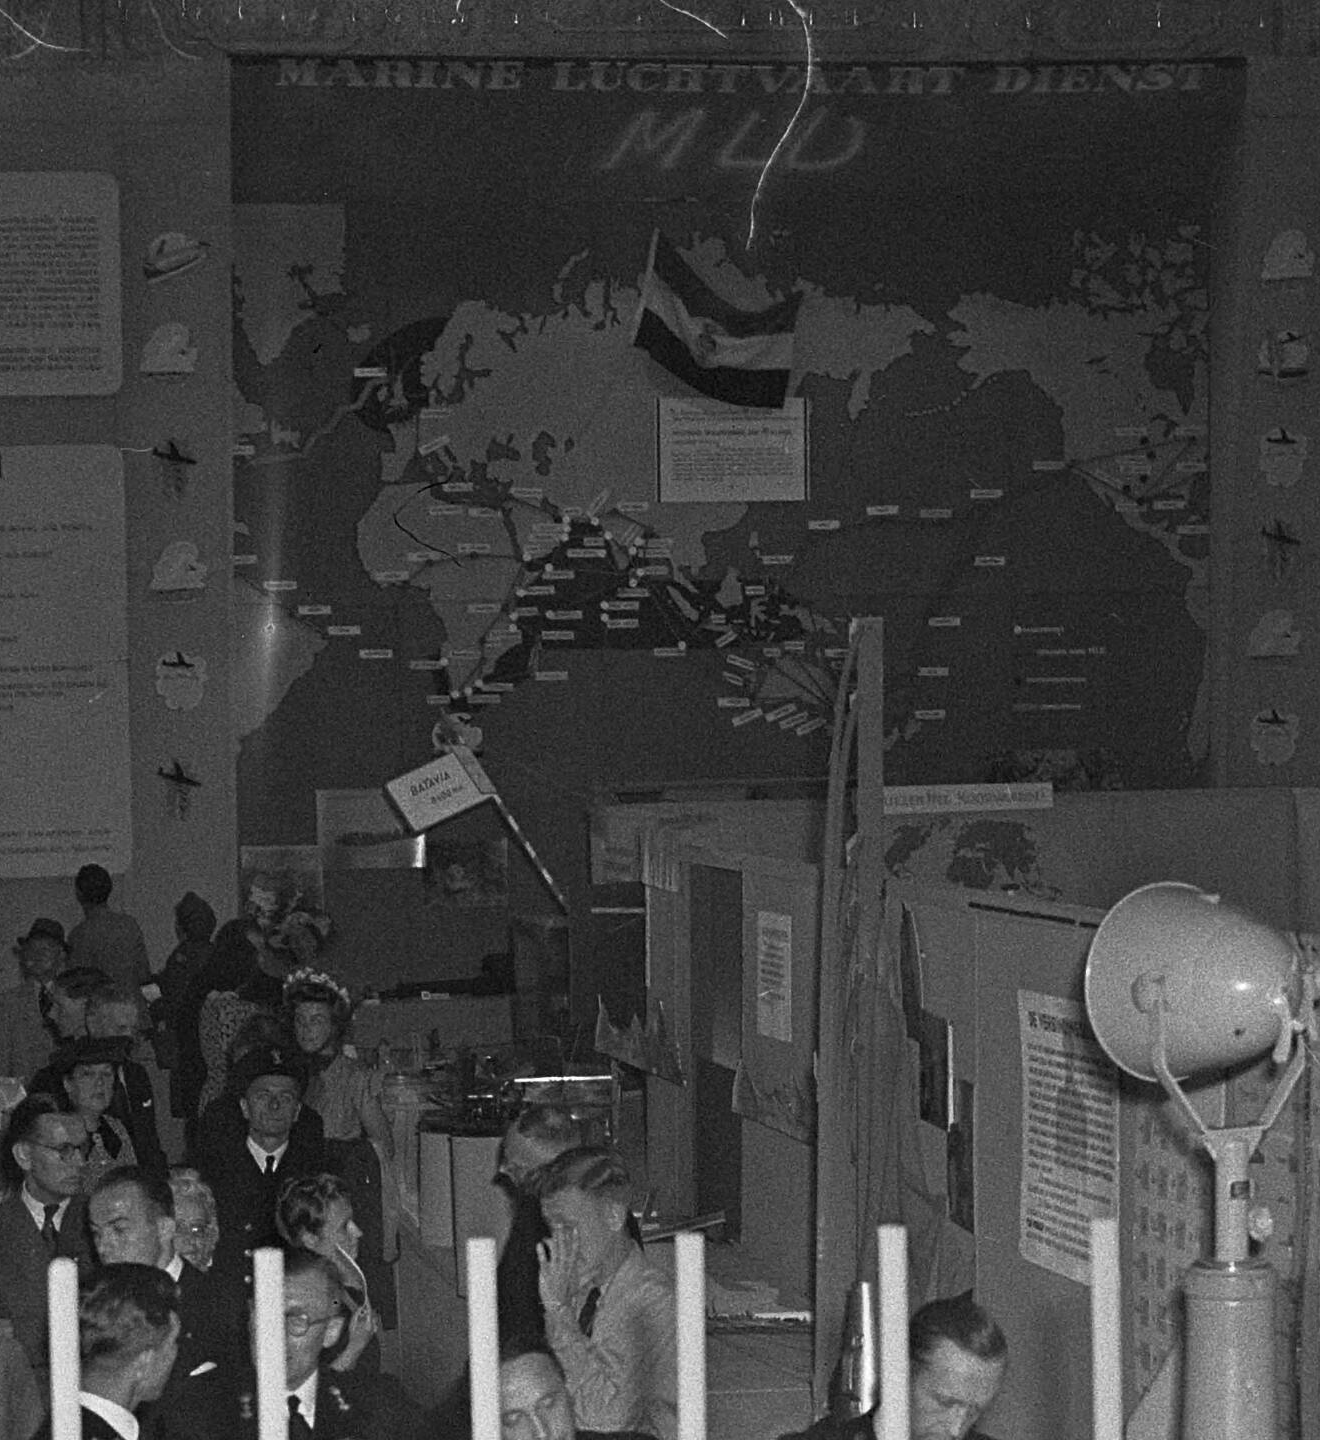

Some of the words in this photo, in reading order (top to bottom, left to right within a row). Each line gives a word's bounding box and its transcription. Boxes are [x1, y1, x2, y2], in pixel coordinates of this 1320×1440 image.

[275, 59, 524, 90] MARINE
[552, 62, 966, 95] LUCHTVAART
[989, 63, 1216, 94] DIENST
[410, 770, 452, 797] BATAVIA
